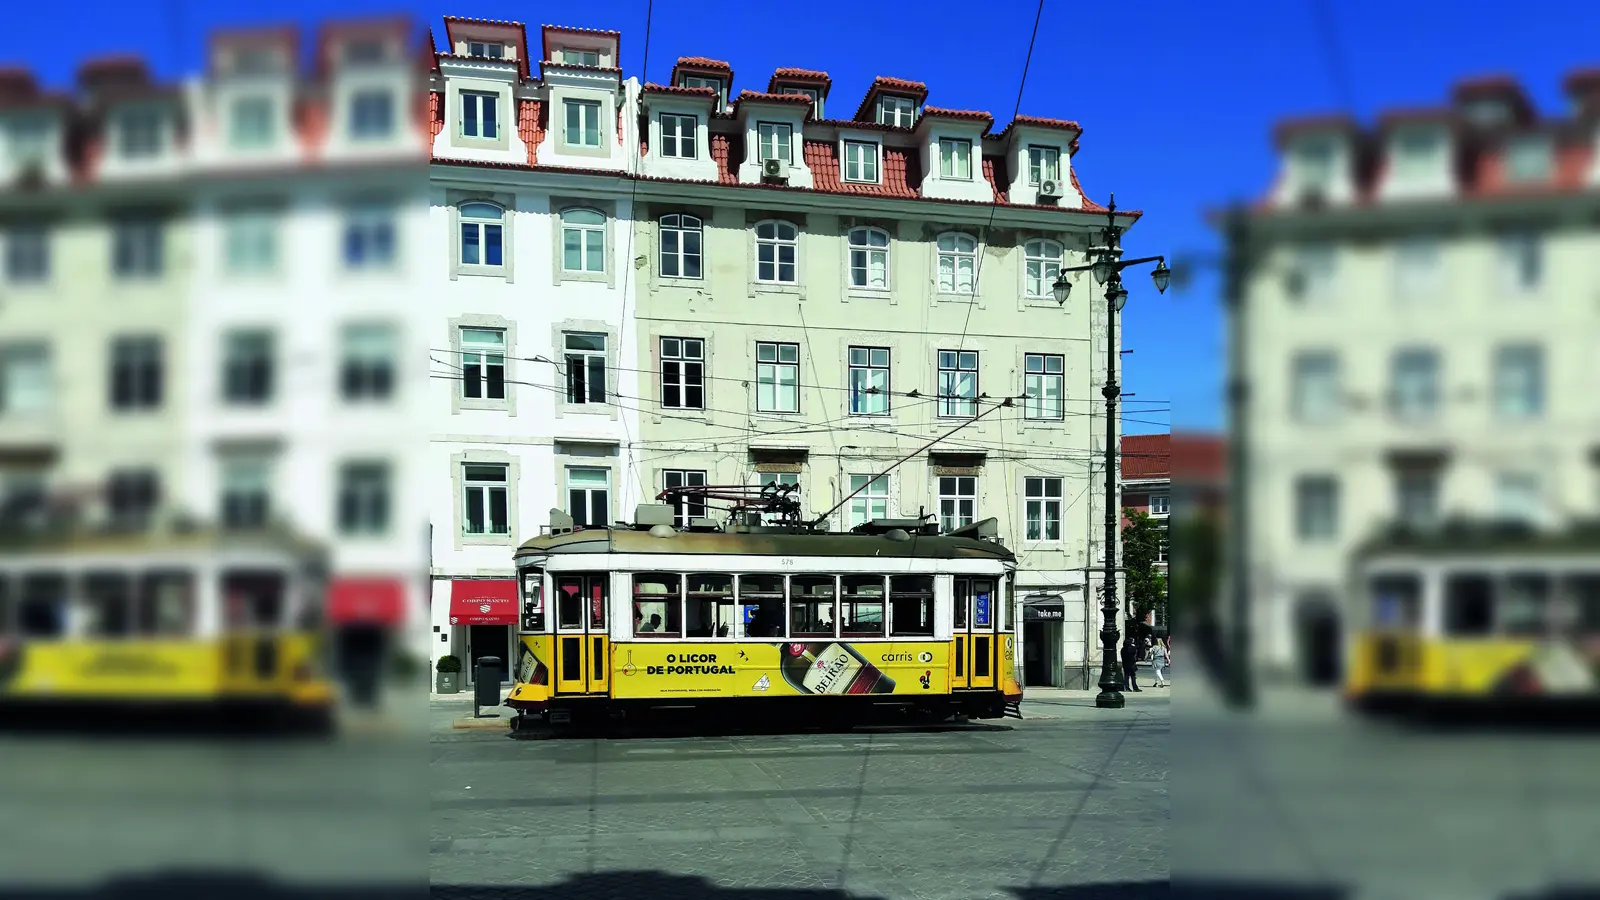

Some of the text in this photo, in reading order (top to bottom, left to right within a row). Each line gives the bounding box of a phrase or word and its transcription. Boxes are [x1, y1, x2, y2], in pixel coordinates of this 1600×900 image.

[781, 558, 794, 566] 578
[666, 654, 717, 663] O LICOR
[881, 650, 913, 662] carris
[646, 665, 736, 674] DE PORTUGAL
[815, 653, 849, 694] BEIRÃO
